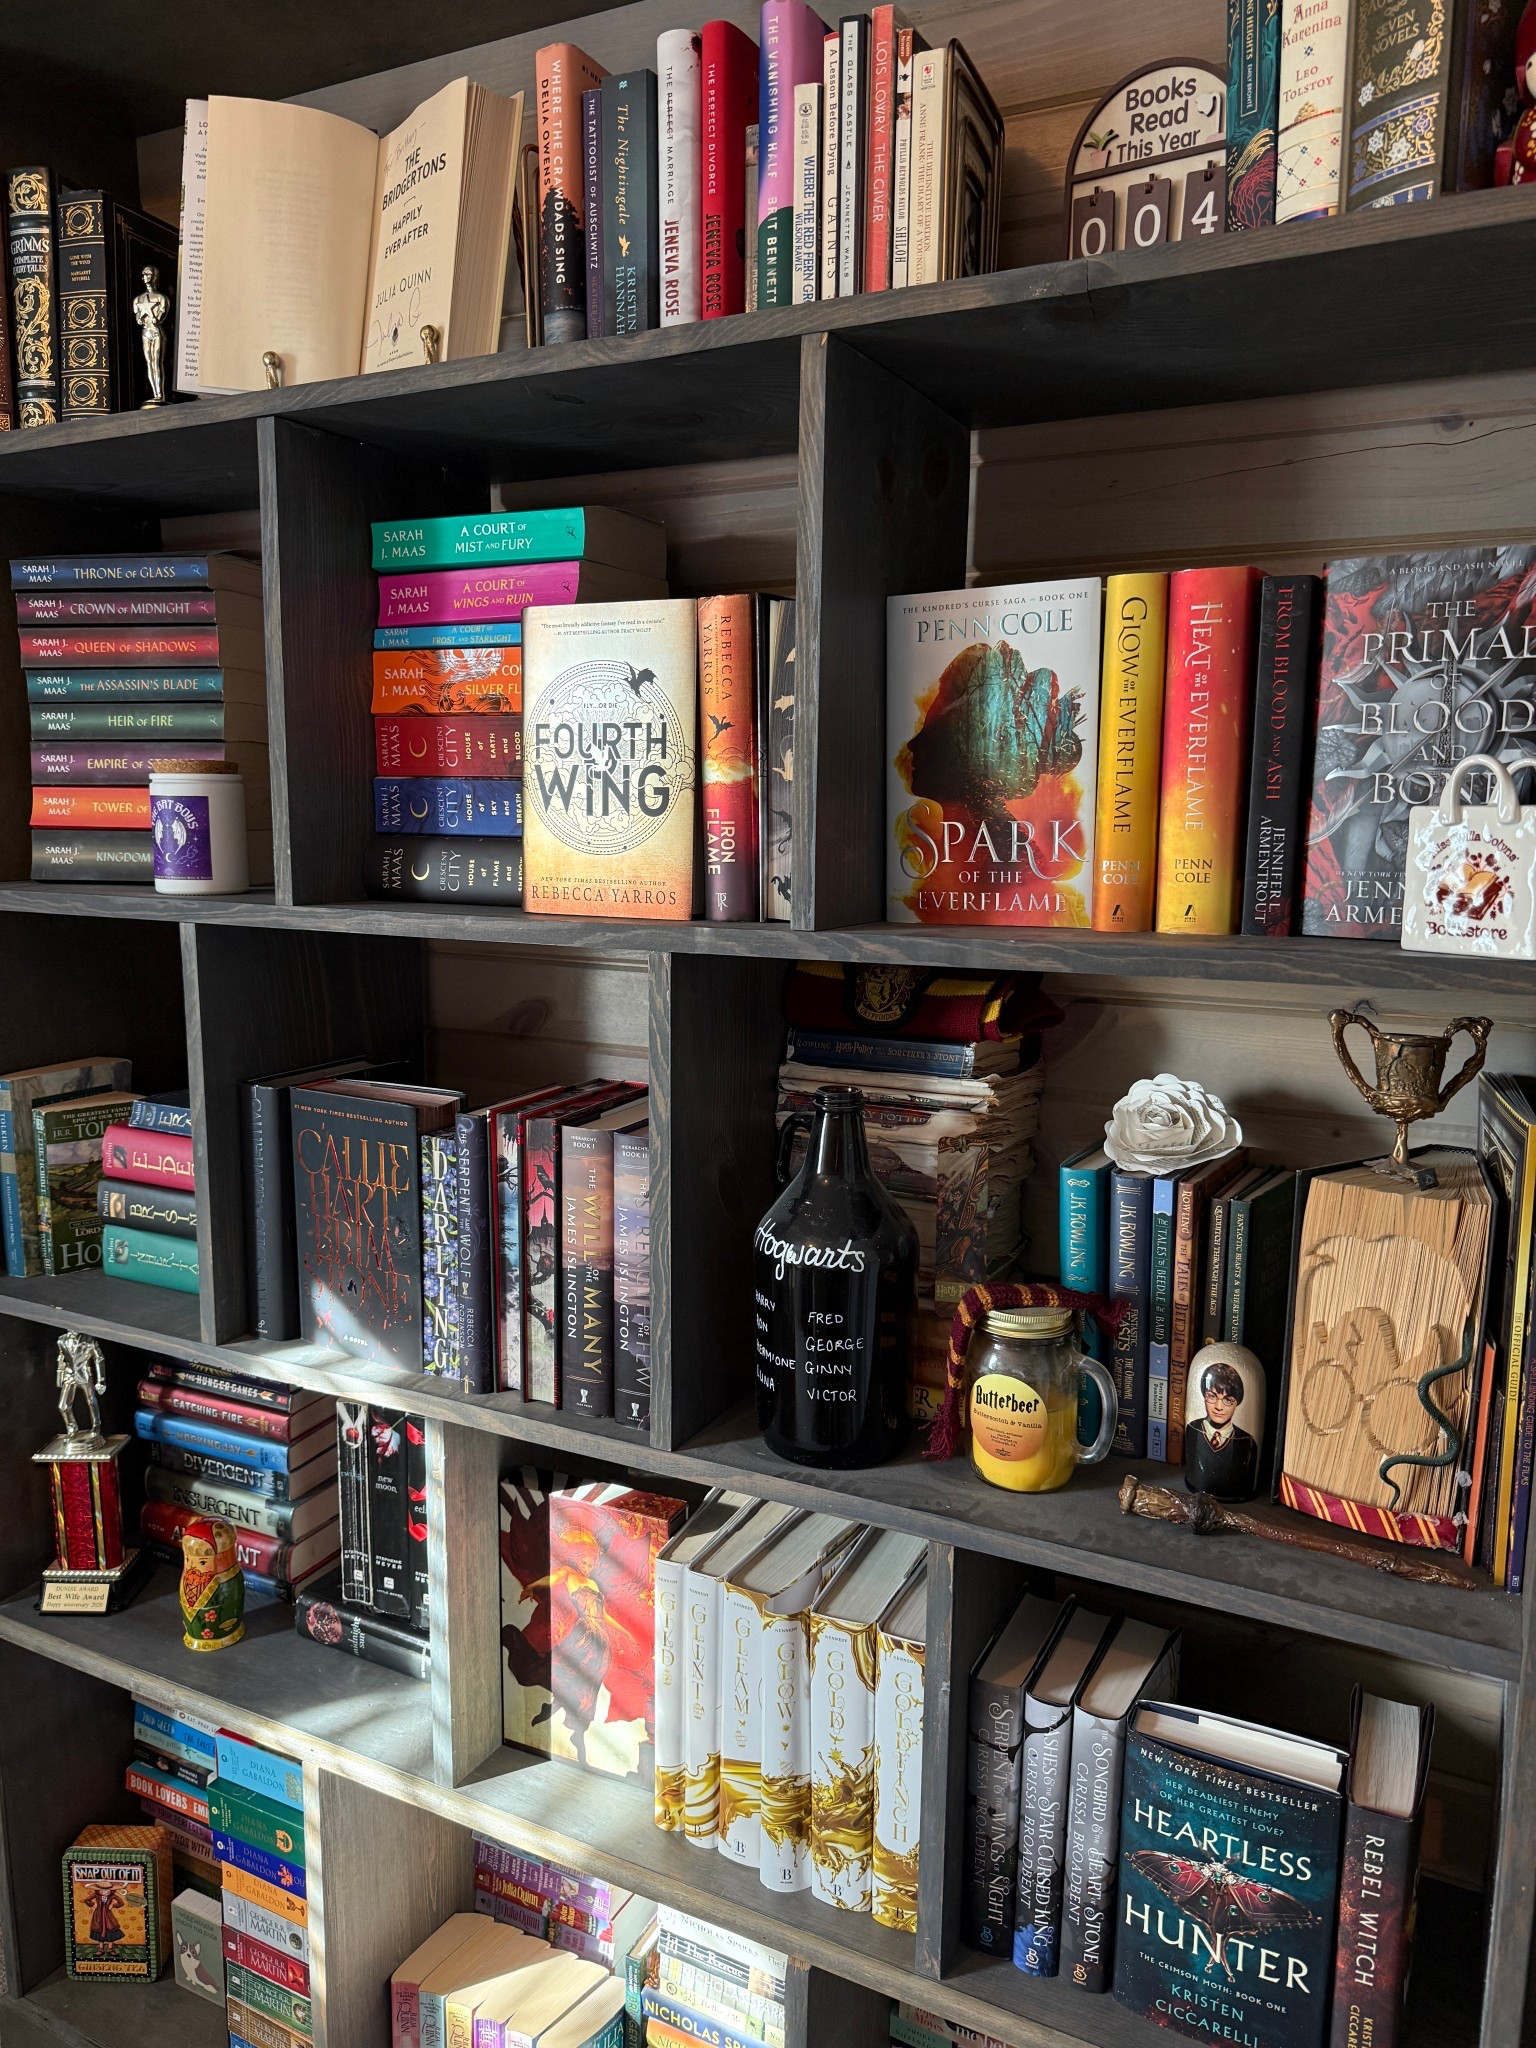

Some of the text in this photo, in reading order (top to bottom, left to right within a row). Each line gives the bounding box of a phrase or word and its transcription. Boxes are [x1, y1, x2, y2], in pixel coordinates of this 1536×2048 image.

[1282, 13, 1342, 50] Karenina
[1293, 3, 1328, 25] Anna
[1375, 8, 1416, 40] SEVEN
[1371, 22, 1420, 56] NOVELS
[1283, 75, 1334, 103] TOLSTOY
[1295, 65, 1319, 83] LEO
[1125, 77, 1196, 112] Books
[541, 78, 551, 186] DELIA OWENS
[666, 92, 674, 143] PERFECT
[872, 40, 887, 223] LOIS LOWRY THE GIVER
[1130, 101, 1189, 136] Read
[404, 146, 421, 174] THE
[766, 15, 779, 305] THE VANISHING HALF BRIT BENNETT
[826, 48, 838, 280] A Lesson Before Dying GAINES
[1116, 127, 1201, 164] This Year
[382, 152, 447, 211] BRIDGERTONS
[551, 59, 567, 284] WHERE THE CRAWDADS SING
[588, 98, 598, 270] THE TATTOOIST OF AUSCHWITZ
[614, 104, 630, 226] The Nightingale
[666, 146, 674, 205] MARRIAGE
[392, 204, 423, 235] HAPPILY
[1133, 204, 1161, 248] 0
[1190, 190, 1219, 235] 4
[10, 236, 50, 255] GRIMM'S
[14, 255, 44, 265] COMPLETE
[384, 222, 429, 260] EVER AFTER
[894, 226, 907, 263] SHILOH
[664, 219, 680, 318] JENEVA ROSE
[843, 246, 851, 278] WALLS
[375, 267, 432, 309] JULIA QUINN
[615, 265, 626, 336] HANNAH
[626, 265, 637, 331] KRISTIN
[383, 529, 424, 543] SARAH
[455, 537, 534, 554] MIST AND FURY
[460, 522, 527, 538] A COURT OF
[381, 544, 427, 559] J. MAAS
[73, 566, 176, 579] THRONE OF GLASS
[916, 608, 1073, 644] PENN COLE
[1117, 596, 1148, 679] GLOW
[74, 640, 197, 654] QUEEN OF SHADOWS
[80, 679, 199, 691] THE ASSASSIN'S BLADE
[1129, 681, 1136, 691] OF
[1265, 584, 1295, 801] FROM BLOOD AND ASH
[107, 715, 174, 727] HEIR OF FIRE
[535, 721, 668, 762] FOURTH
[1112, 696, 1138, 833] EVERFLAME
[533, 764, 670, 818] WING
[706, 808, 721, 875] FLAME
[720, 820, 736, 863] IRON
[900, 803, 1090, 880] SPARK
[531, 885, 677, 905] REBECCA YARROS
[958, 870, 1023, 884] OF THE
[918, 891, 1067, 914] EVERFLAME
[754, 1217, 866, 1281] Hogwarts
[1117, 1201, 1137, 1279] JK ROWLING
[432, 1150, 449, 1370] DARLING
[566, 1196, 577, 1339] JAMES ISLINGTON
[583, 1168, 602, 1375] THE WILL OF THE MANY
[1209, 1205, 1223, 1317] QUIDDITCH THROUGH THE AGES
[807, 1311, 844, 1325] FRED
[805, 1336, 865, 1352] GEORGE
[804, 1361, 852, 1376] GINNY
[173, 1398, 244, 1425] CATCHING FIRE
[807, 1387, 857, 1402] VICTOR
[975, 1384, 1040, 1414] Butterbeer
[184, 1452, 265, 1488] DIVERGENT
[377, 1475, 393, 1483] new
[172, 1487, 261, 1527] INSURGENT
[82, 1593, 105, 1601] Award
[660, 1591, 675, 1667] GILD
[734, 1616, 751, 1716] GLEAM
[776, 1641, 796, 1721] GLOW
[826, 1650, 846, 1734] GOLD
[242, 1765, 285, 1793] GABALDON
[249, 1759, 276, 1778] DIANA
[1140, 1747, 1320, 1813] NEW YORK TIMES BESTSELLER
[130, 1774, 188, 1811] BOOK LOVERS
[1020, 1746, 1039, 1909] CARISSA BROADBENT
[1134, 1798, 1312, 1882] HEARTLESS
[75, 1867, 140, 1881] SNAP OUT OF IT
[1354, 1832, 1386, 1987] REBEL WITCH
[1125, 1893, 1311, 1995] HUNTER
[250, 1956, 288, 1982] MARTIN
[644, 1997, 720, 2045] NICHOLAS
[1171, 1983, 1244, 2023] KRISTEN
[1155, 1999, 1259, 2048] CICCARELLI
